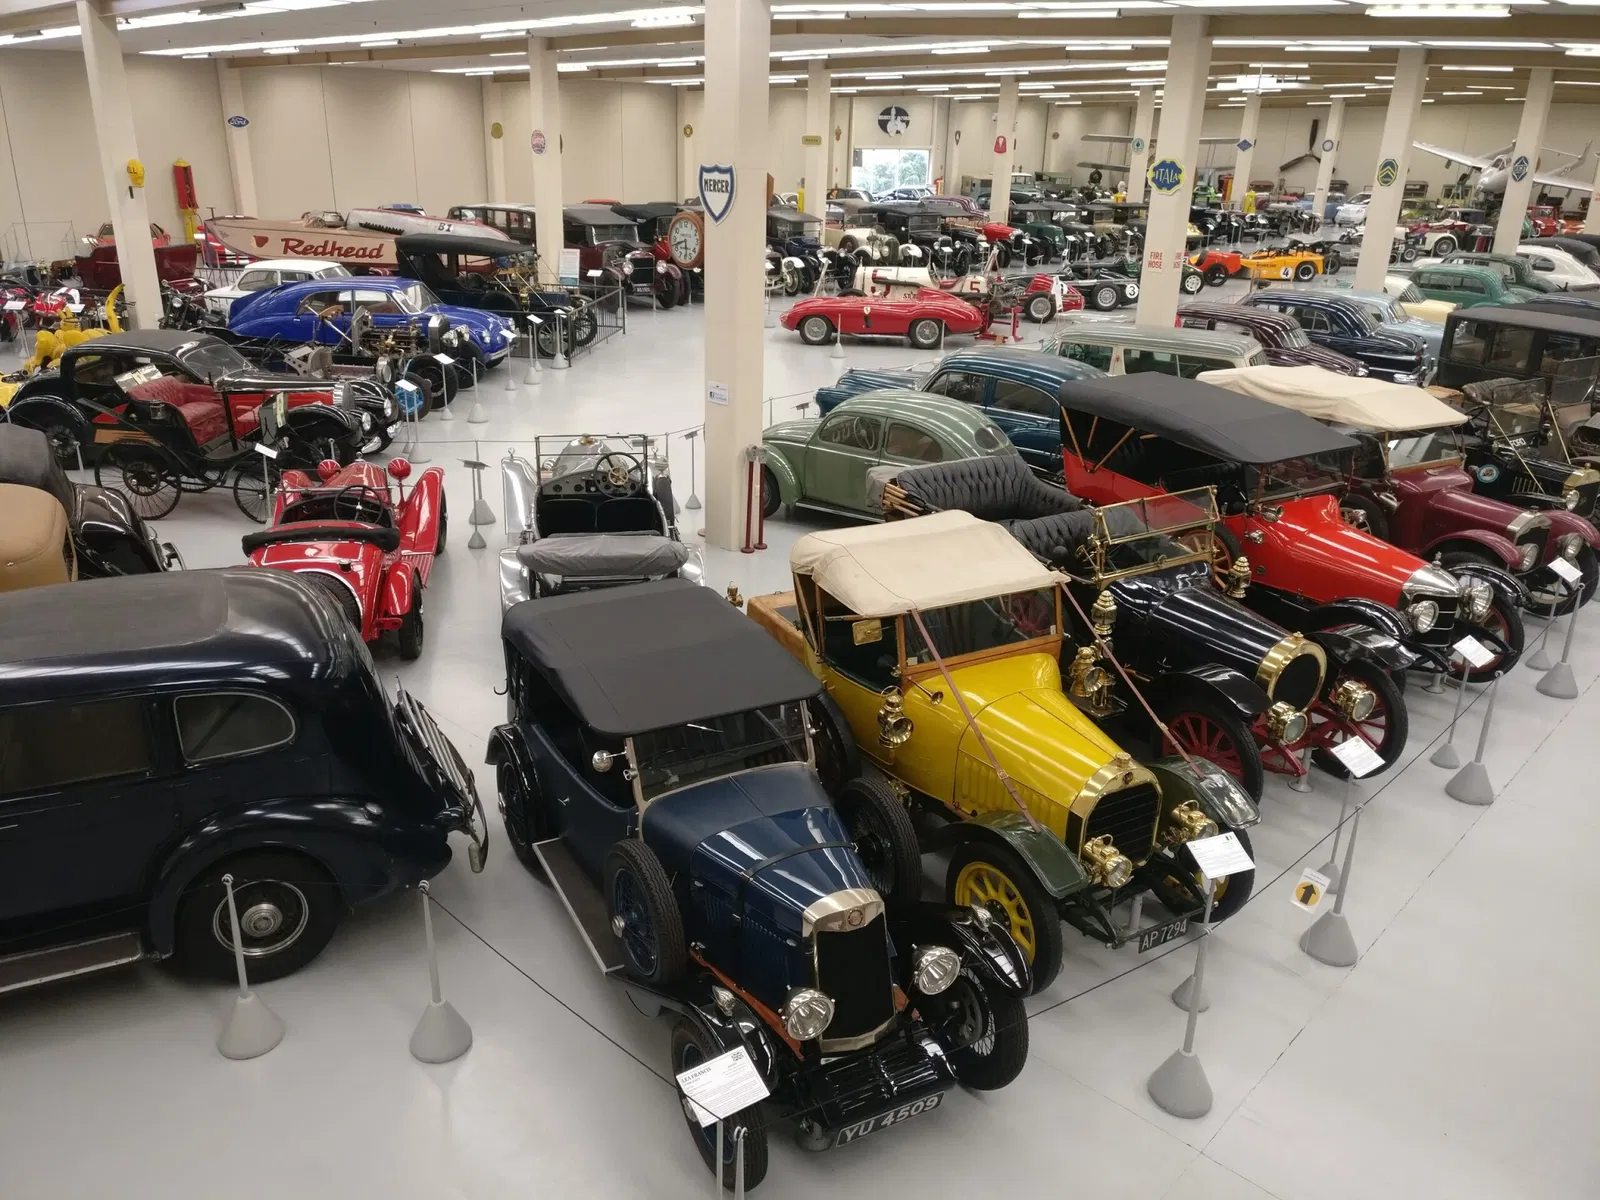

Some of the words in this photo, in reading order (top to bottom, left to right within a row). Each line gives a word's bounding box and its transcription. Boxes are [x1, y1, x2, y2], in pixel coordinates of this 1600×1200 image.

[229, 116, 248, 127] Ford
[704, 178, 730, 193] MERCER
[438, 222, 453, 233] B1
[281, 237, 385, 259] Redhead
[1150, 251, 1163, 260] FIRE
[1148, 260, 1163, 270] HOSE
[1283, 267, 1289, 277] 4
[970, 281, 981, 293] 5
[1129, 286, 1136, 296] 3
[1510, 437, 1526, 448] FORD
[1141, 931, 1159, 951] AP
[1160, 918, 1188, 943] 7294
[681, 1075, 692, 1083] LEA
[691, 1067, 712, 1080] FRANCIS
[844, 1120, 875, 1142] YU
[880, 1096, 939, 1127] 4509
